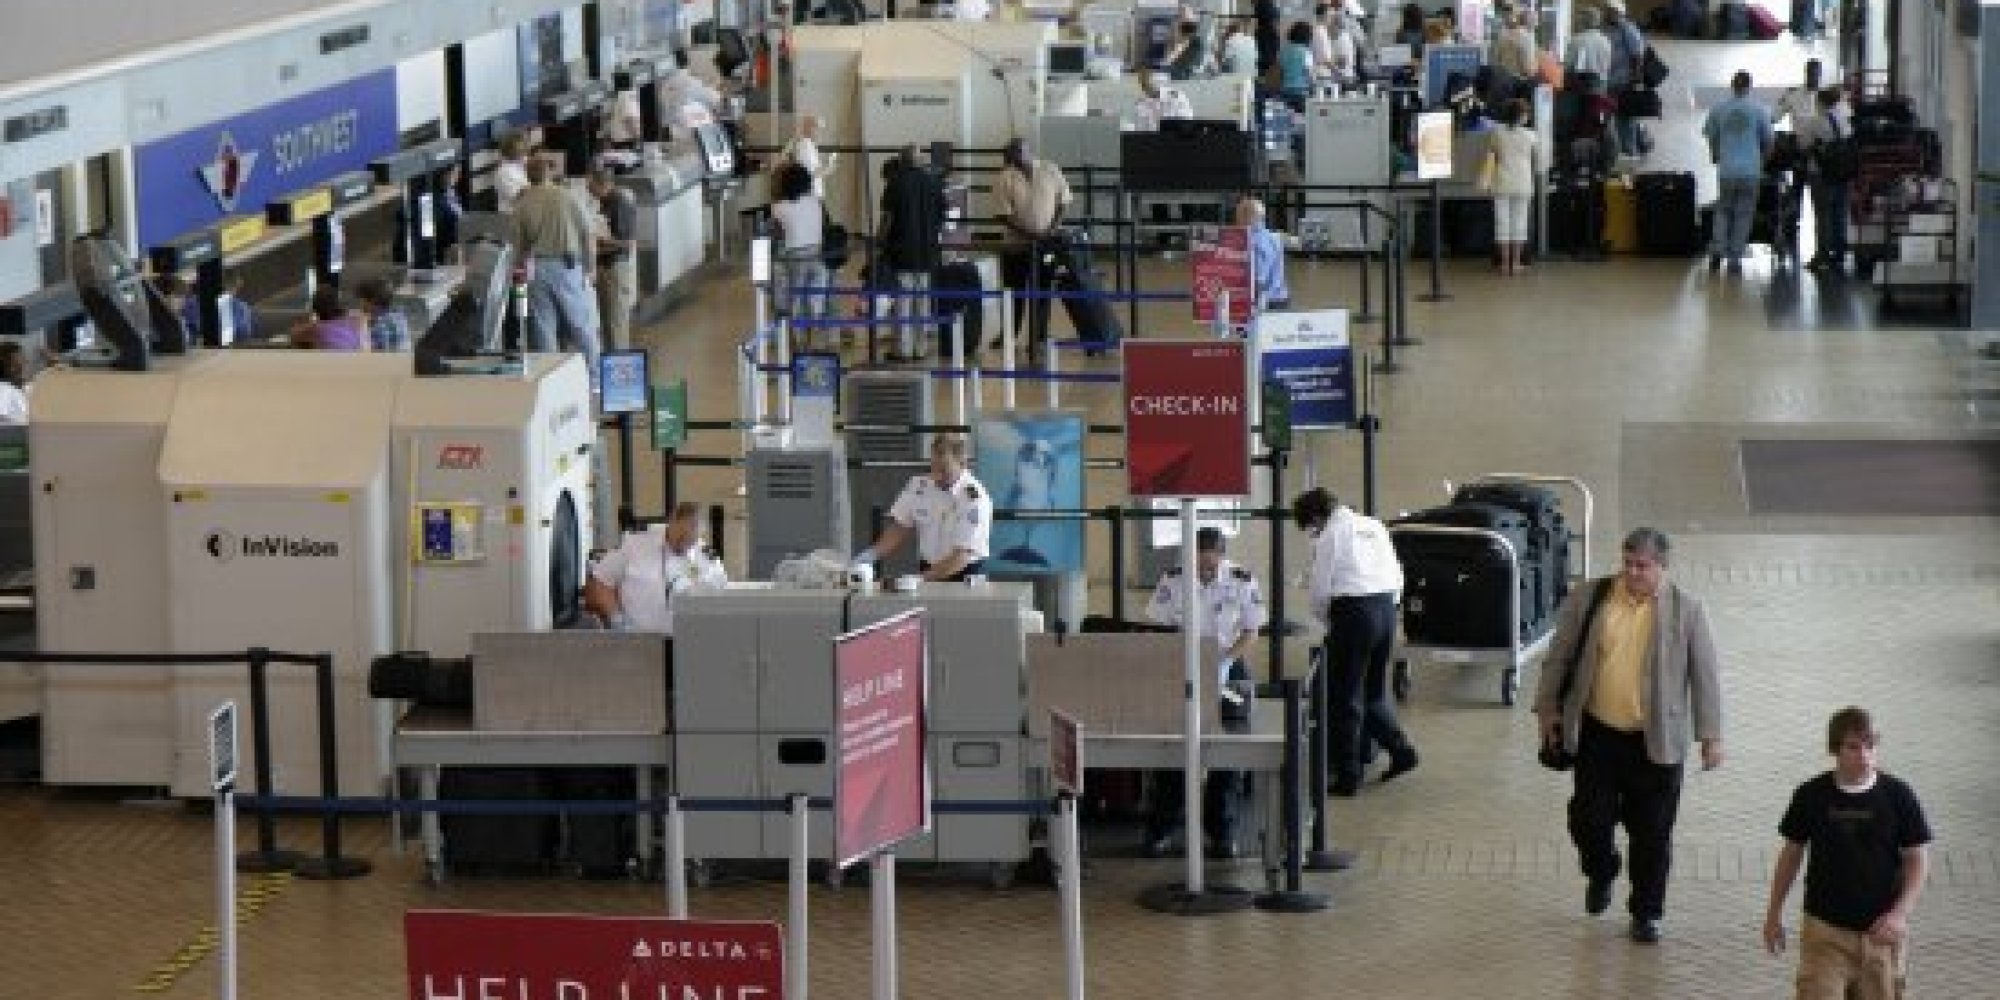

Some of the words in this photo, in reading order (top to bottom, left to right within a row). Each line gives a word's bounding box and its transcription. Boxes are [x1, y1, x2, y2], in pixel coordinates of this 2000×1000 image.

[273, 109, 358, 176] SOUTHWEST
[1131, 395, 1238, 416] CHECK-IN
[242, 534, 339, 557] InVision
[660, 940, 747, 959] DELTA
